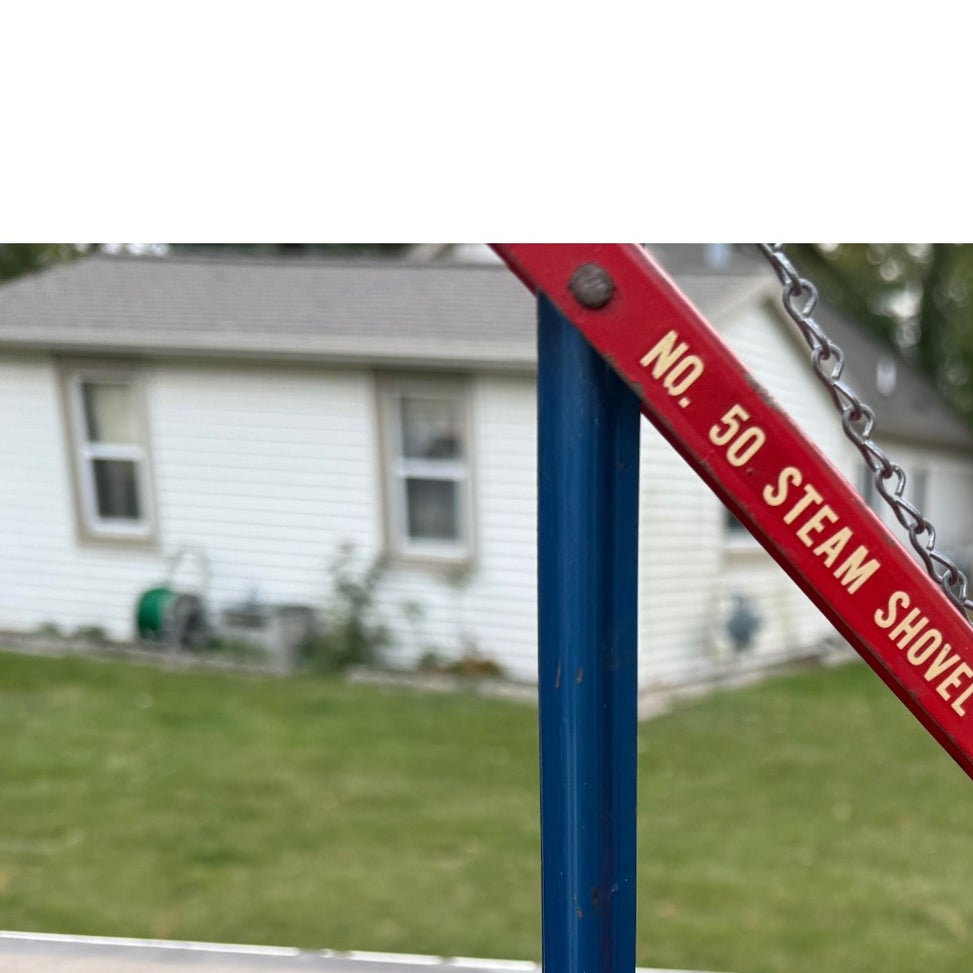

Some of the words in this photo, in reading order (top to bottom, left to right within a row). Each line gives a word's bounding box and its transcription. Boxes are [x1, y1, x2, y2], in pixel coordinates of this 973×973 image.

[639, 330, 704, 409] NO.
[709, 404, 766, 467] 50
[762, 466, 881, 595] STEAM
